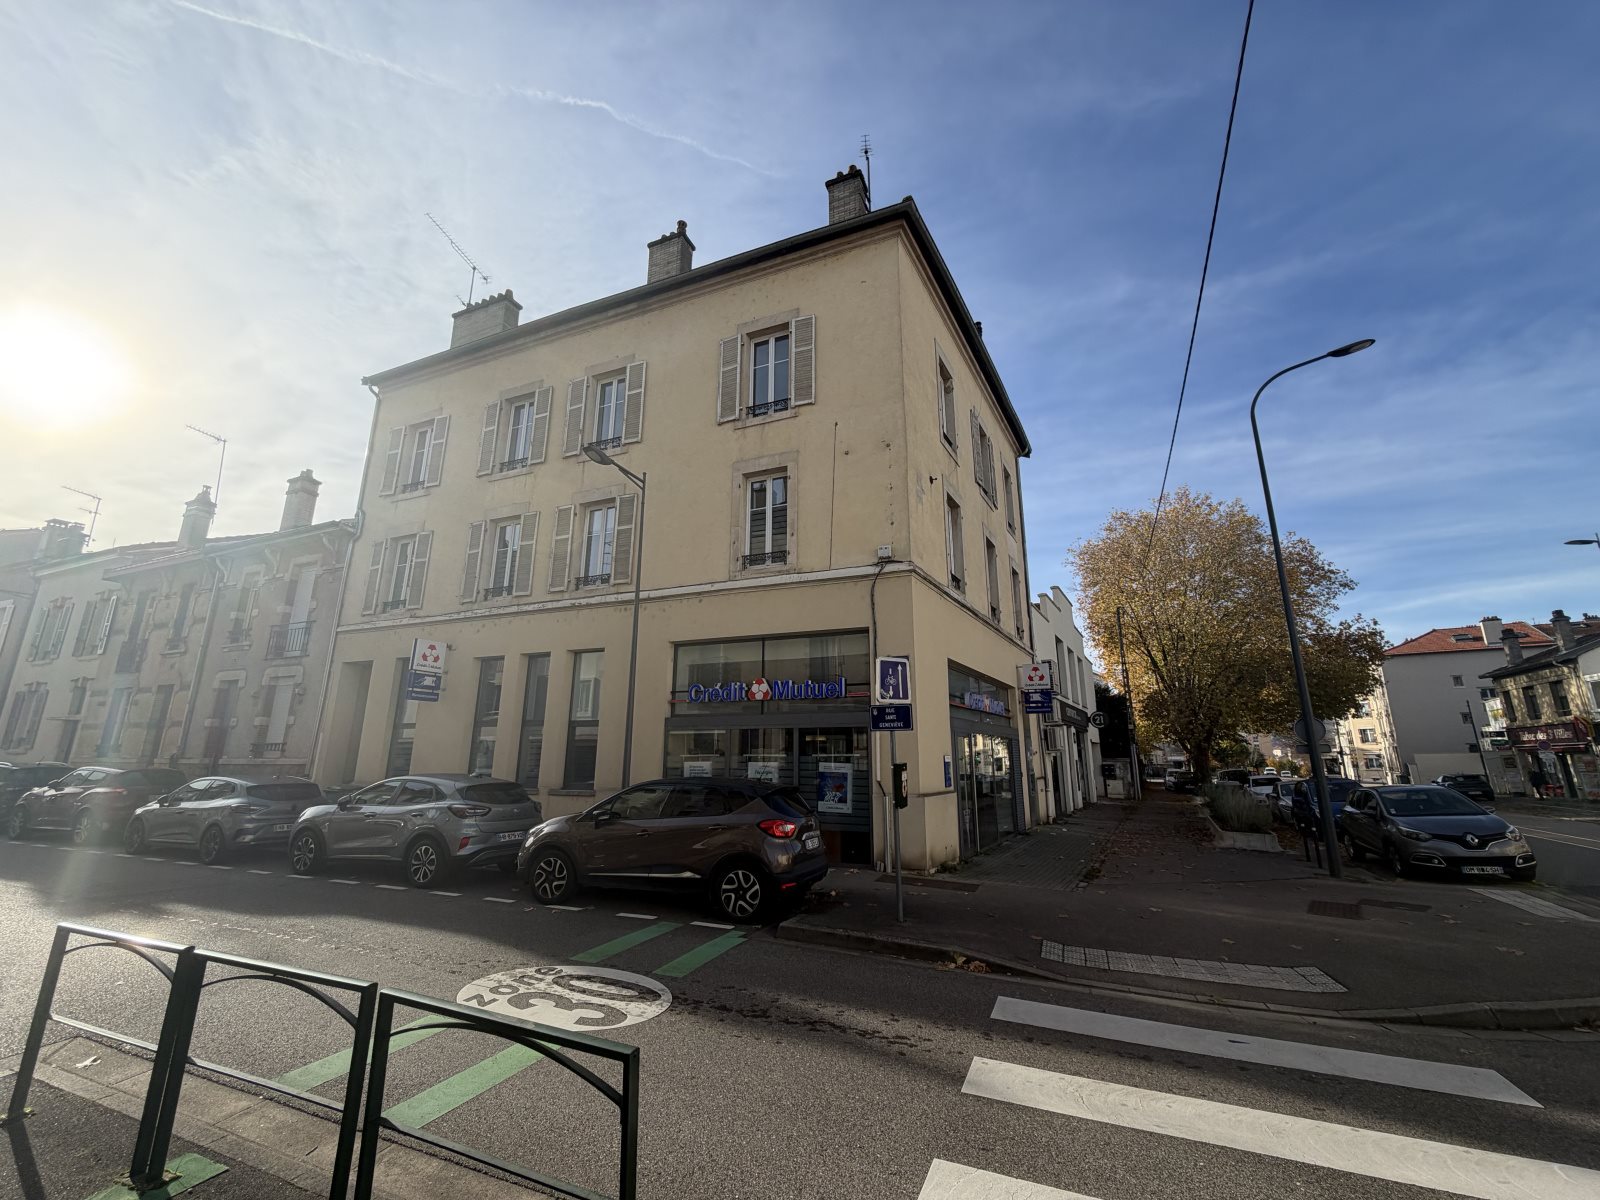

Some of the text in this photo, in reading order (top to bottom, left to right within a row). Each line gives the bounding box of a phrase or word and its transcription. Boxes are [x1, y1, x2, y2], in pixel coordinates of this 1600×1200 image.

[687, 677, 848, 704] Crédit Mutuel
[463, 966, 563, 1007] zone
[507, 974, 662, 1027] 30
